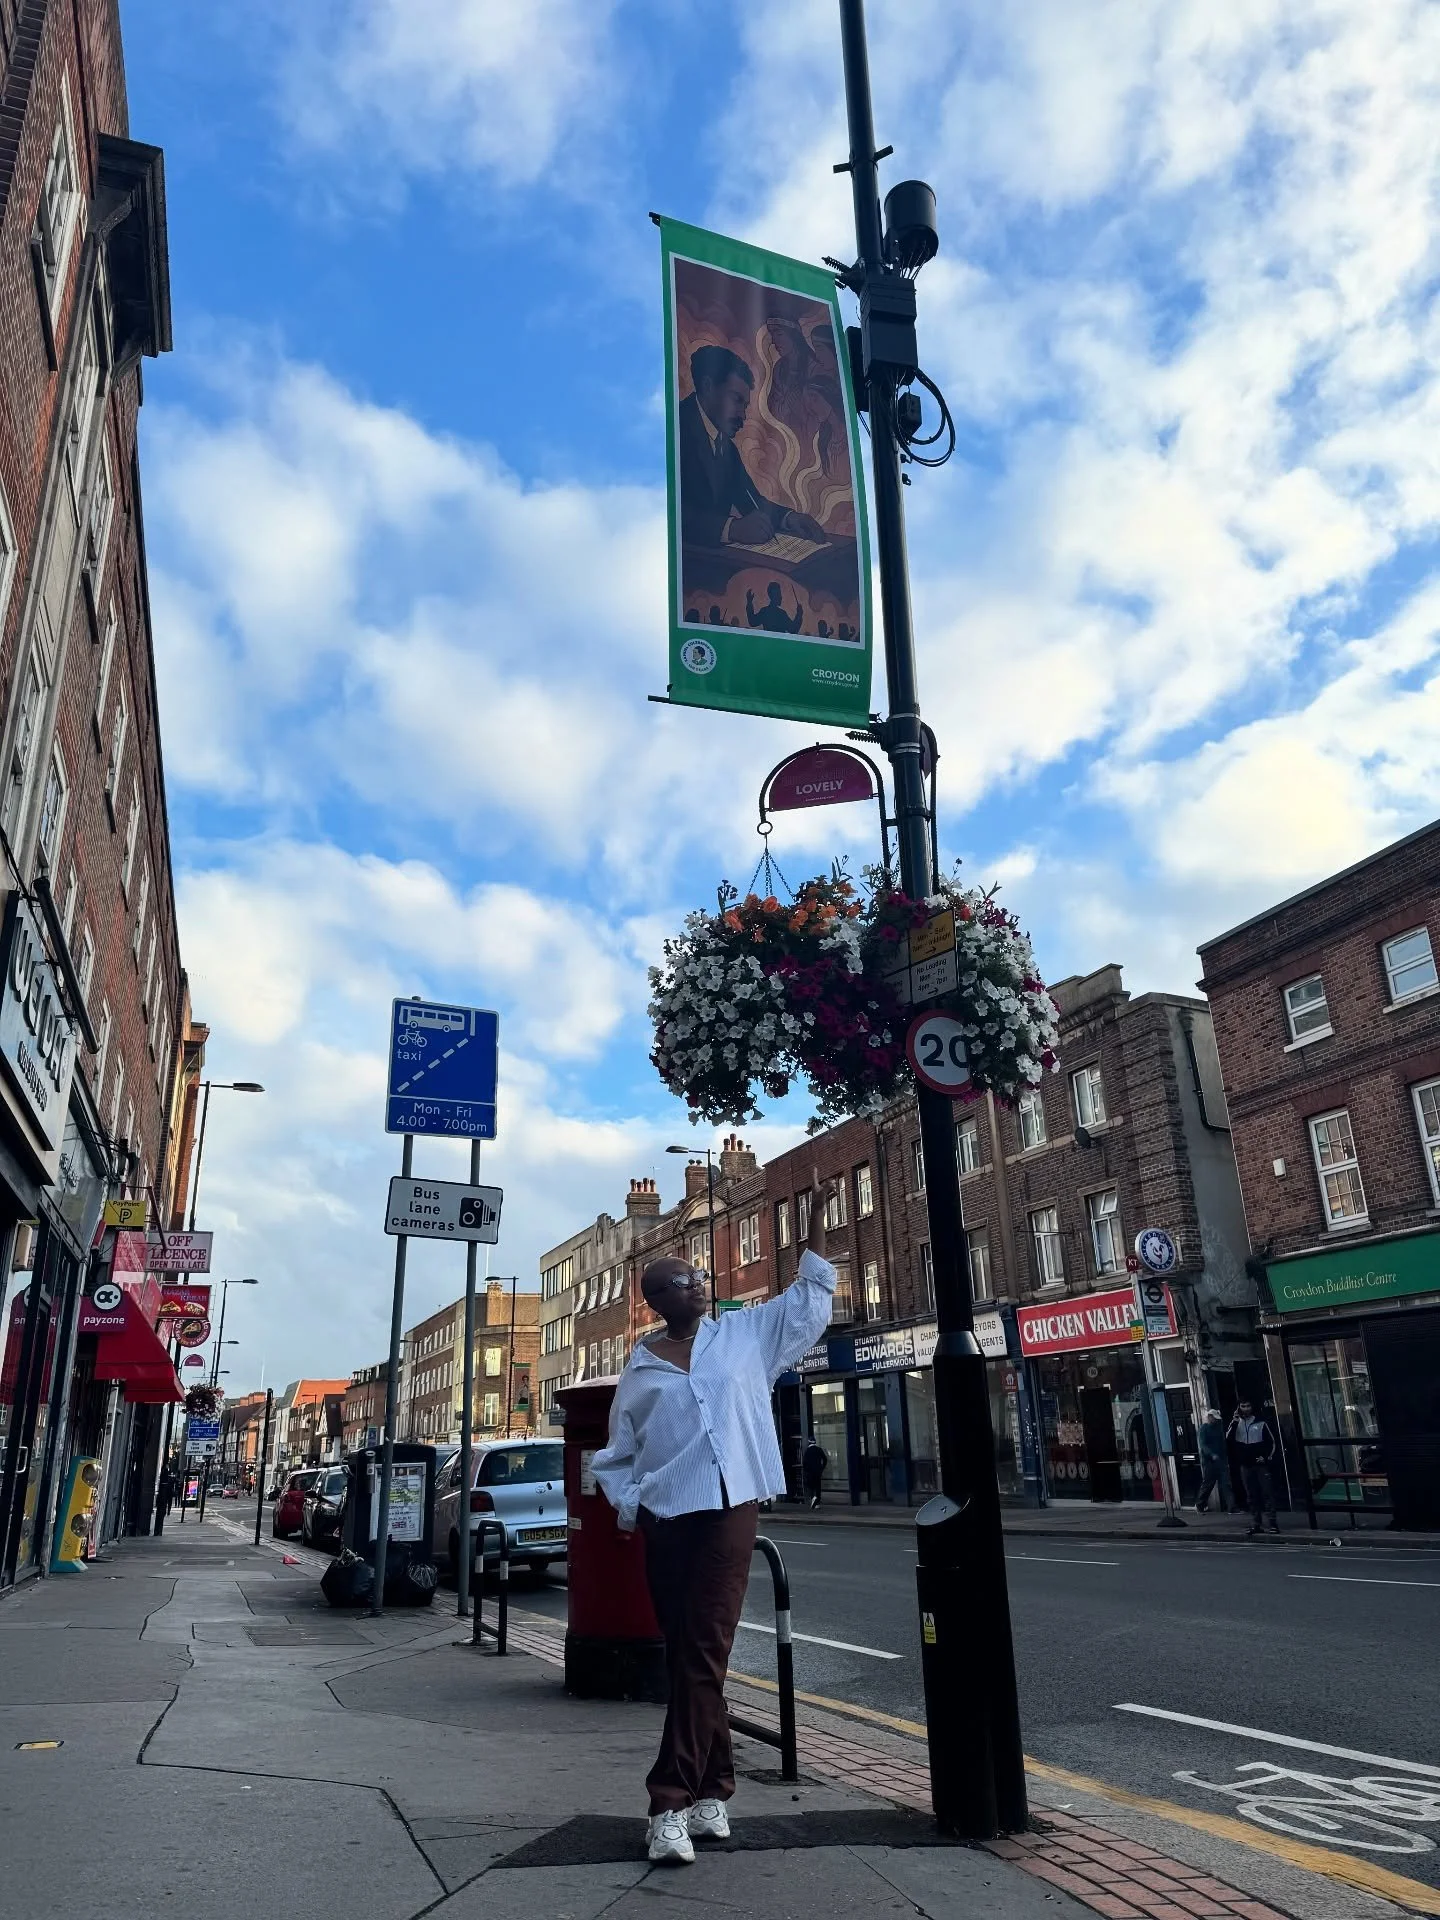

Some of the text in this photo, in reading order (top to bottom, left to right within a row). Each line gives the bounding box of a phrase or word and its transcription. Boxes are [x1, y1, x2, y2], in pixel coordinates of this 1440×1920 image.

[811, 668, 860, 683] CROYDON
[795, 779, 844, 795] LOVELY
[925, 959, 947, 971] Loading
[397, 1049, 422, 1061] taxi
[920, 1033, 968, 1069] 20
[413, 1102, 440, 1115] Mon
[456, 1106, 472, 1118] Fri
[396, 1115, 426, 1128] 4.00
[443, 1118, 487, 1133] 7.00pm
[413, 1186, 440, 1200] Bus
[112, 1200, 140, 1208] PayPoint
[409, 1200, 441, 1215] lane
[391, 1216, 455, 1232] cameras
[167, 1235, 193, 1247] OFF
[151, 1248, 207, 1260] LICENCE
[150, 1260, 206, 1269] OPEN TILL LATE
[1283, 1271, 1397, 1302] Croydon Buddhist Centre
[83, 1315, 125, 1326] payzone
[1022, 1313, 1085, 1344] CHICKEN
[1086, 1303, 1139, 1334] VALLEY
[920, 1320, 997, 1341] CHART EYORS
[854, 1335, 877, 1346] STUART
[855, 1339, 914, 1362] EDWARDS
[803, 1357, 829, 1369] SURVEYORS
[524, 1530, 546, 1541] GU54
